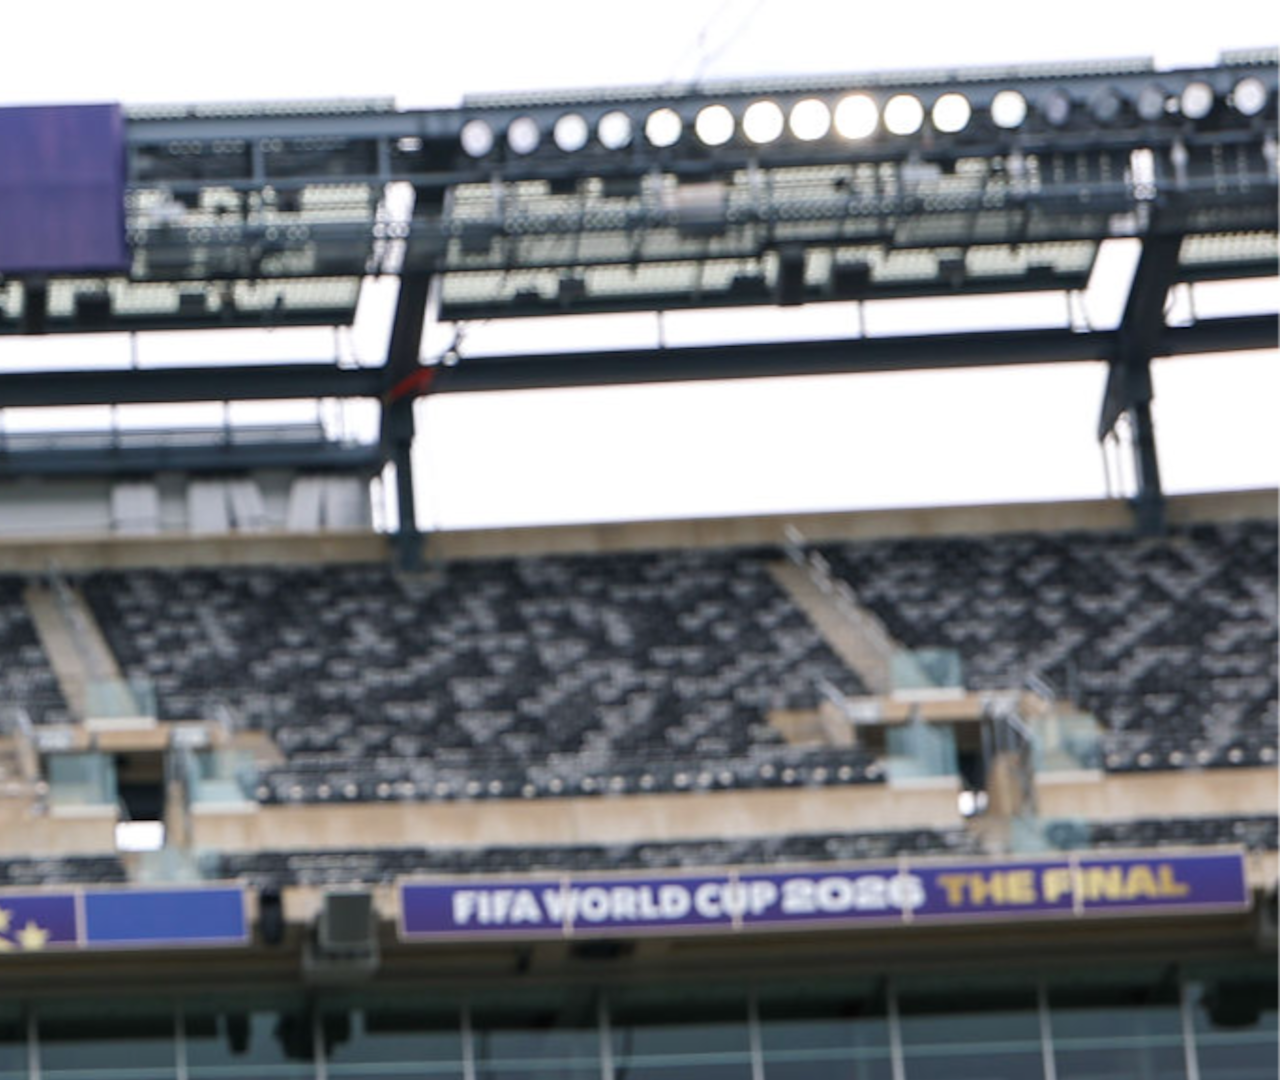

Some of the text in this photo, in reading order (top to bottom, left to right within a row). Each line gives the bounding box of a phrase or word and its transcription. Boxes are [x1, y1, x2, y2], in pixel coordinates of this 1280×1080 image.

[452, 865, 1192, 925] FIFA WORLD CUP 2026 THE FINAL
